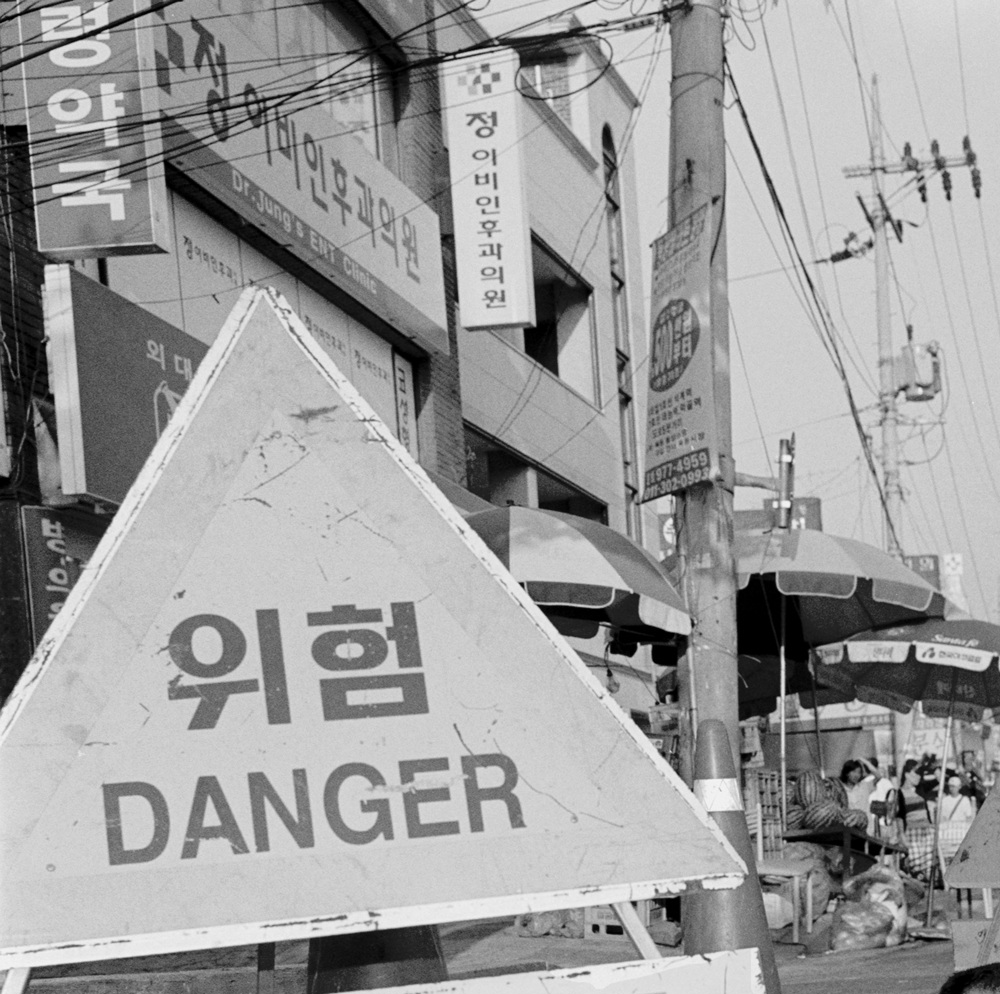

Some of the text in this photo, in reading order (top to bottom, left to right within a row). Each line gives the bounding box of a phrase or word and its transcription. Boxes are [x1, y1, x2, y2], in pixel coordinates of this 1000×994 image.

[310, 235, 338, 264] ENT
[465, 110, 507, 310] 정이비인후과의원
[167, 601, 430, 730] 위험
[101, 752, 527, 866] DANGER
